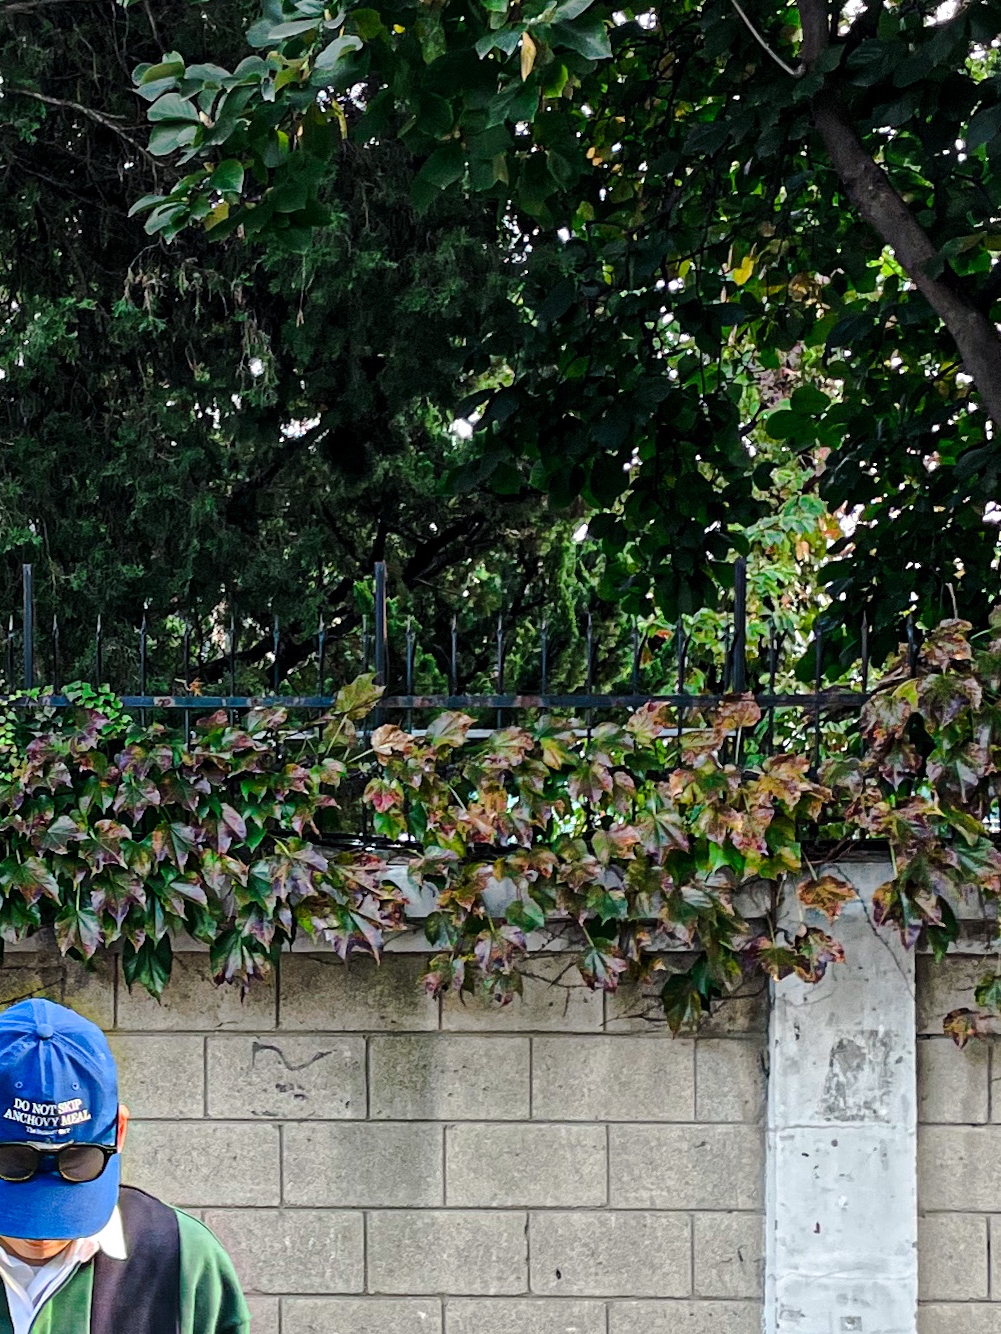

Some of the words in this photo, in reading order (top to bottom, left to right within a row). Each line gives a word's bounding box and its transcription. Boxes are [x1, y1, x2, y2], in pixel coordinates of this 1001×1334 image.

[13, 1098, 30, 1112] DO
[32, 1103, 57, 1116] NOT
[58, 1099, 82, 1115] SKIP
[3, 1109, 59, 1127] ANCHOVY
[60, 1110, 92, 1126] MEAL
